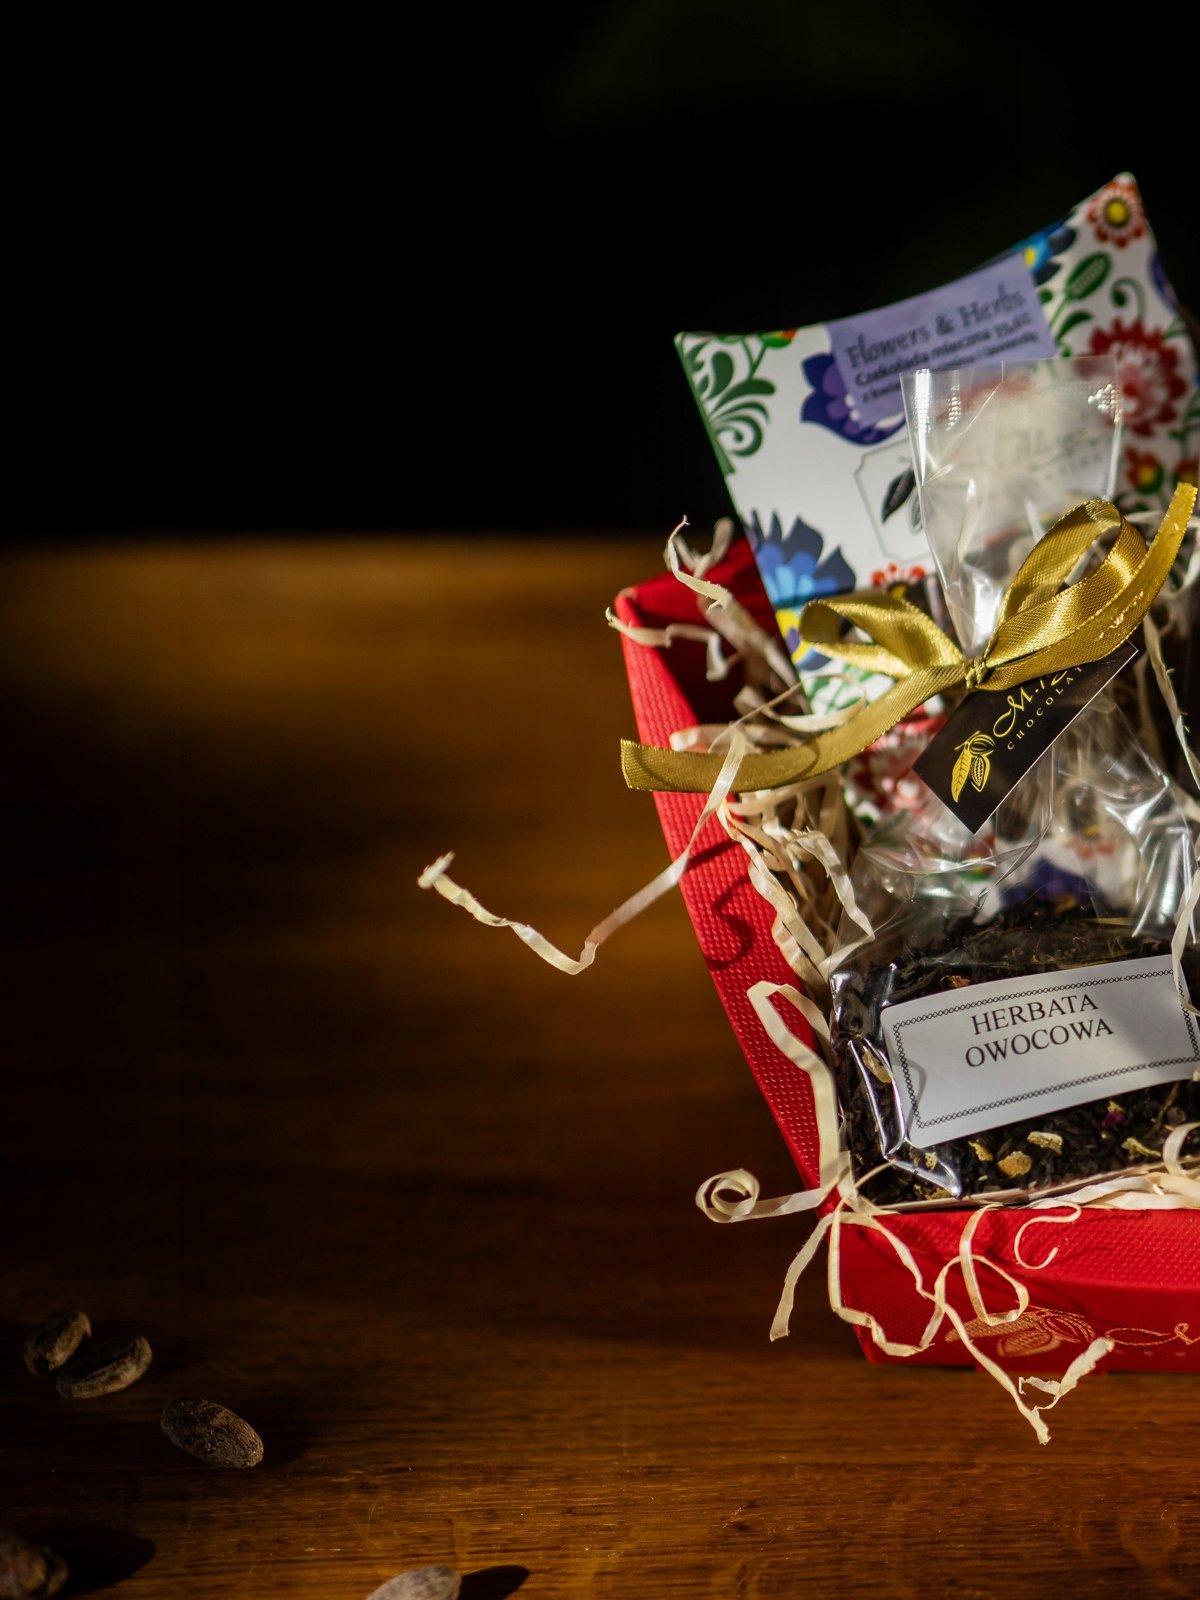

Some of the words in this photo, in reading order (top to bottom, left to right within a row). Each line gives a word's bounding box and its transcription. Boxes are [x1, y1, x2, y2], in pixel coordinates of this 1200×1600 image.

[847, 326, 931, 369] Flowers
[935, 314, 954, 336] &
[958, 281, 1027, 328] Herbs
[854, 351, 930, 387] Czekolada
[970, 993, 1099, 1036] HERBATA
[964, 1017, 1115, 1069] OWOCOWA
